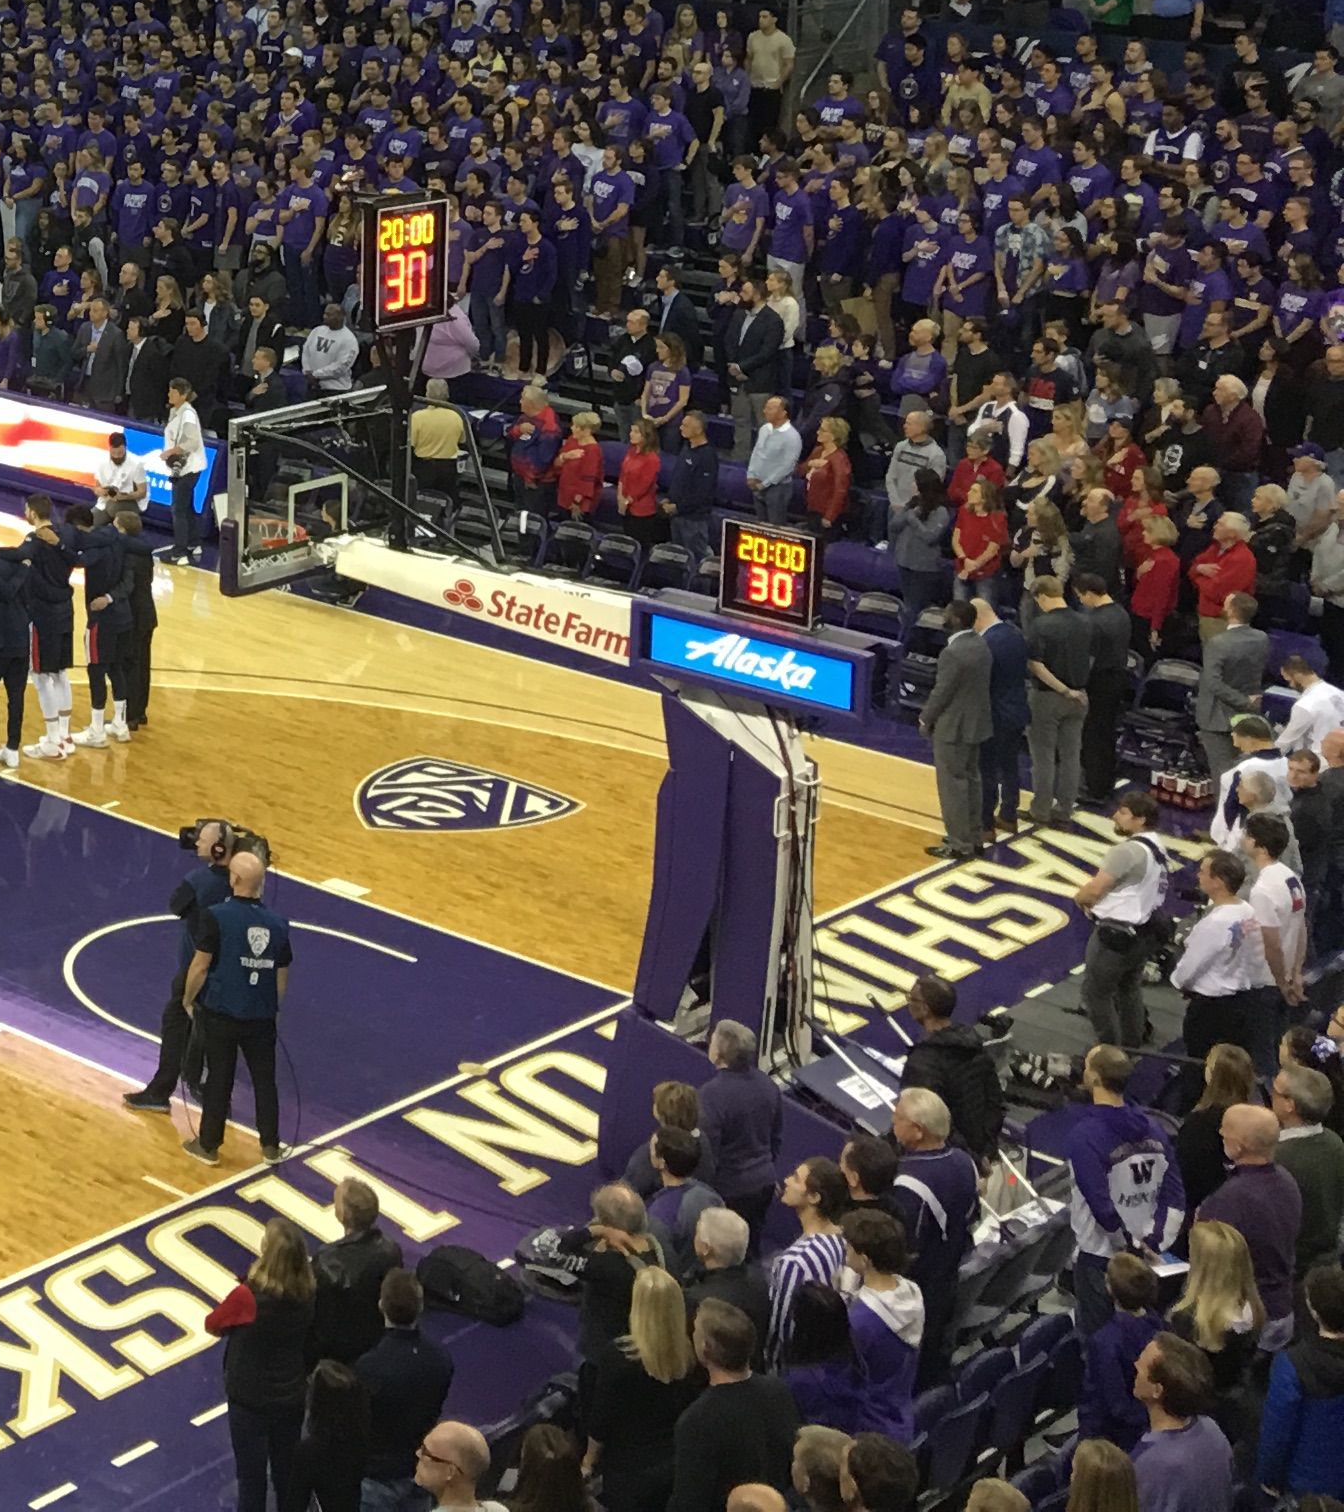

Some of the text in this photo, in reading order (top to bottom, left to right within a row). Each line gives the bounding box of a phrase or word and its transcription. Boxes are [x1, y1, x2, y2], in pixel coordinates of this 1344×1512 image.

[380, 213, 434, 251] 20:00
[386, 250, 427, 311] 30
[316, 336, 335, 353] W
[738, 534, 806, 572] 20:00
[750, 566, 793, 608] 30
[685, 633, 817, 689] Alaska
[1130, 1159, 1155, 1185] W
